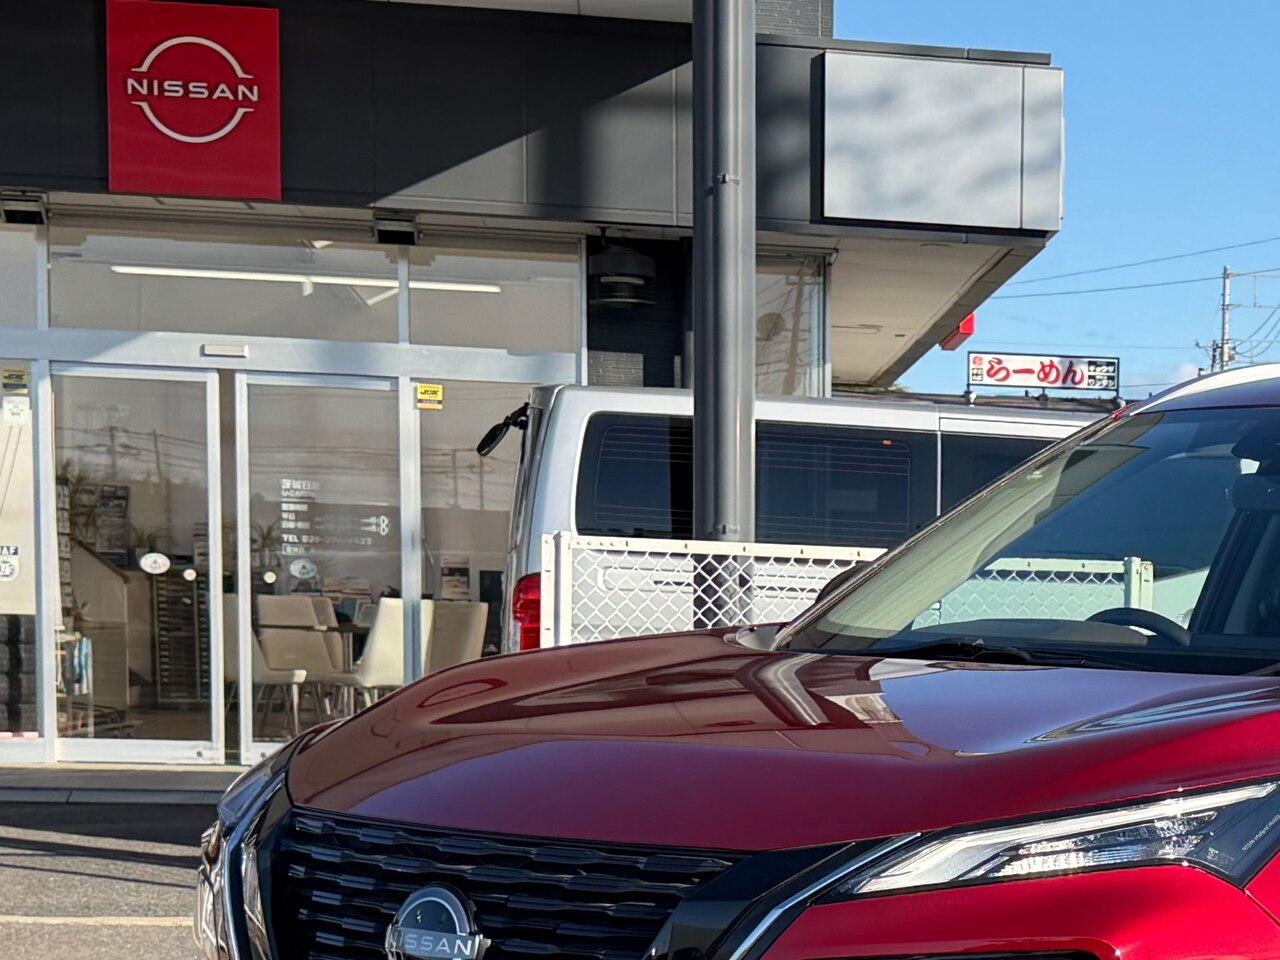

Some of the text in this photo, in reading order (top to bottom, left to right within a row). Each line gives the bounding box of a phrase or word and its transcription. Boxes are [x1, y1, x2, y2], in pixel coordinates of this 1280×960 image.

[126, 77, 259, 102] NISSAN
[986, 357, 1085, 386] らーめん
